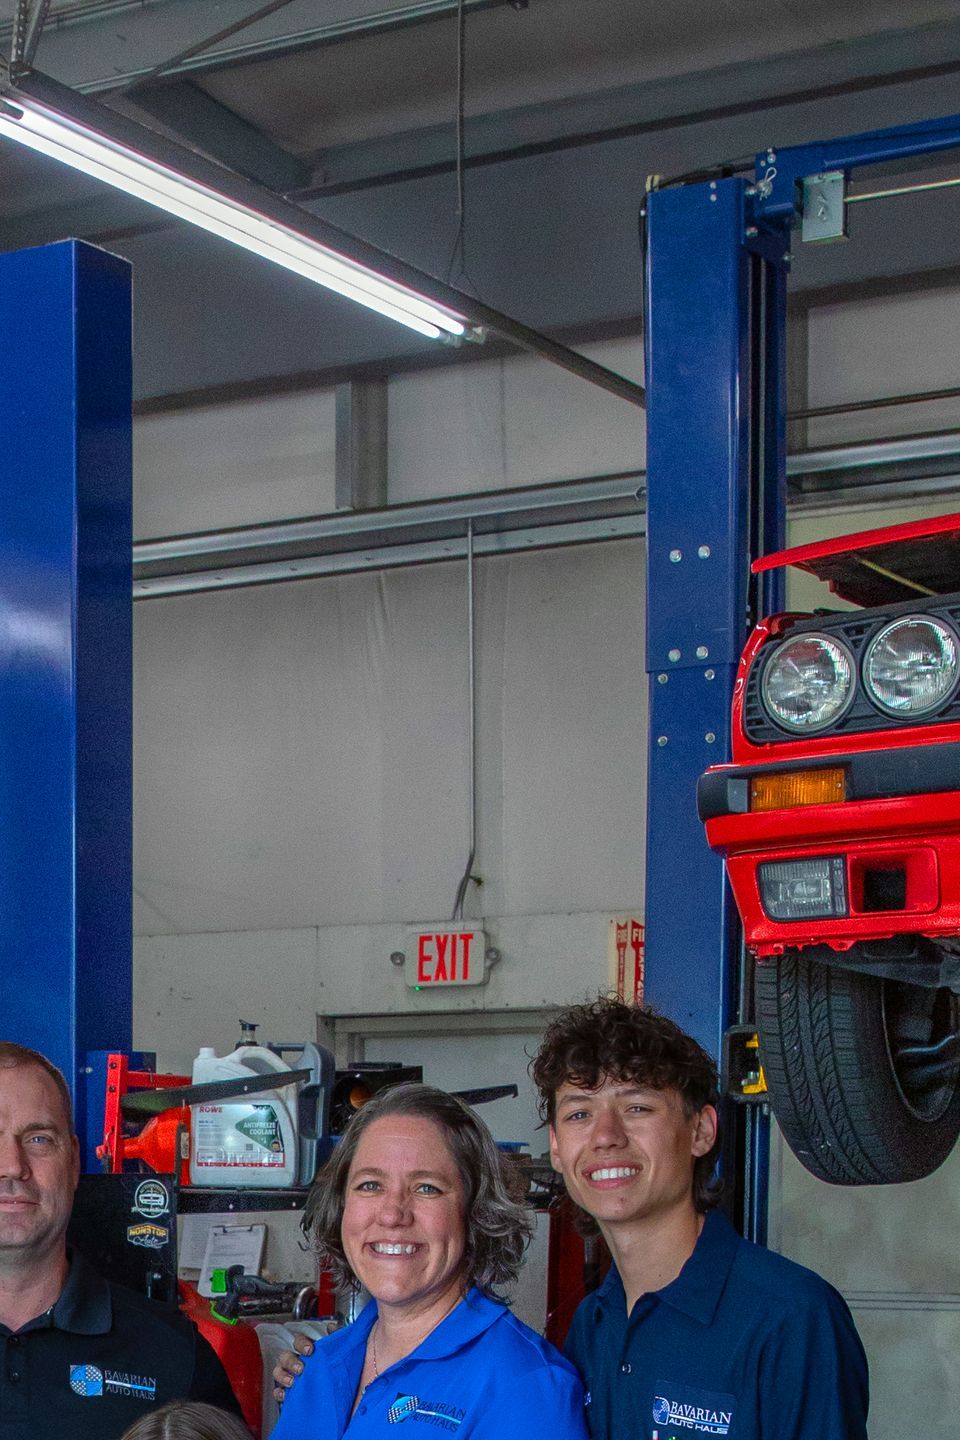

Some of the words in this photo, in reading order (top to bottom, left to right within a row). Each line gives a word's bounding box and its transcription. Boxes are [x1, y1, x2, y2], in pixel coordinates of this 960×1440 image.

[417, 933, 474, 983] EXIT
[243, 1121, 276, 1129] ANTIFREEZE
[249, 1128, 276, 1136] COOLANT
[129, 1224, 167, 1238] NONSTOP
[104, 1369, 157, 1388] BAVARIAN
[105, 1383, 131, 1396] AUTO
[131, 1387, 156, 1401] HAUS
[670, 1401, 733, 1425] BAVARIAN
[668, 1417, 694, 1429] AUTO
[694, 1424, 729, 1435] HAUS
